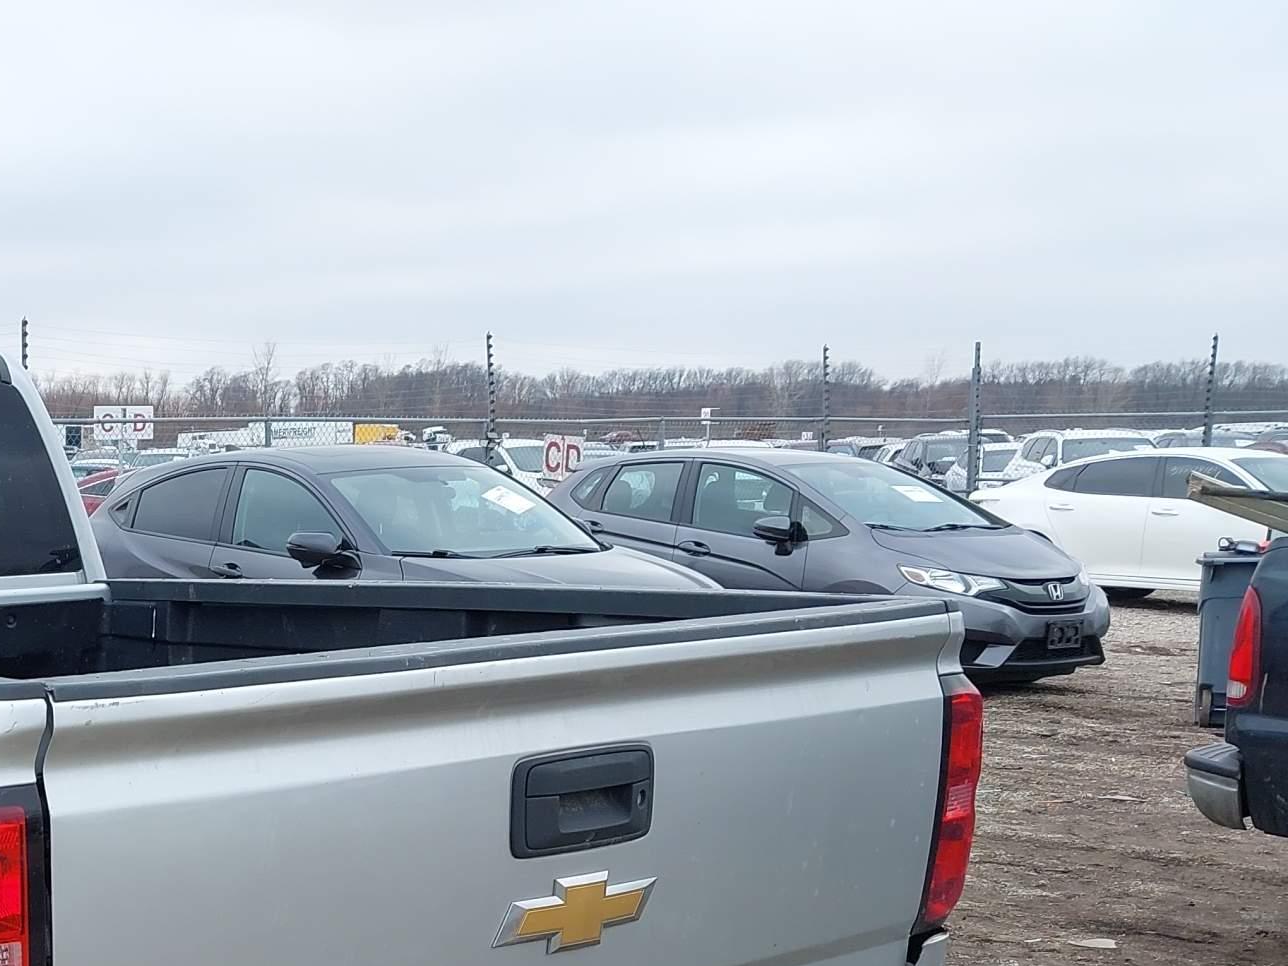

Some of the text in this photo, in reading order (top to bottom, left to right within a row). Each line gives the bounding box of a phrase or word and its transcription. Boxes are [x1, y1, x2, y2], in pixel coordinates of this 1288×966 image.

[100, 413, 146, 432] C D
[545, 441, 581, 473] C D
